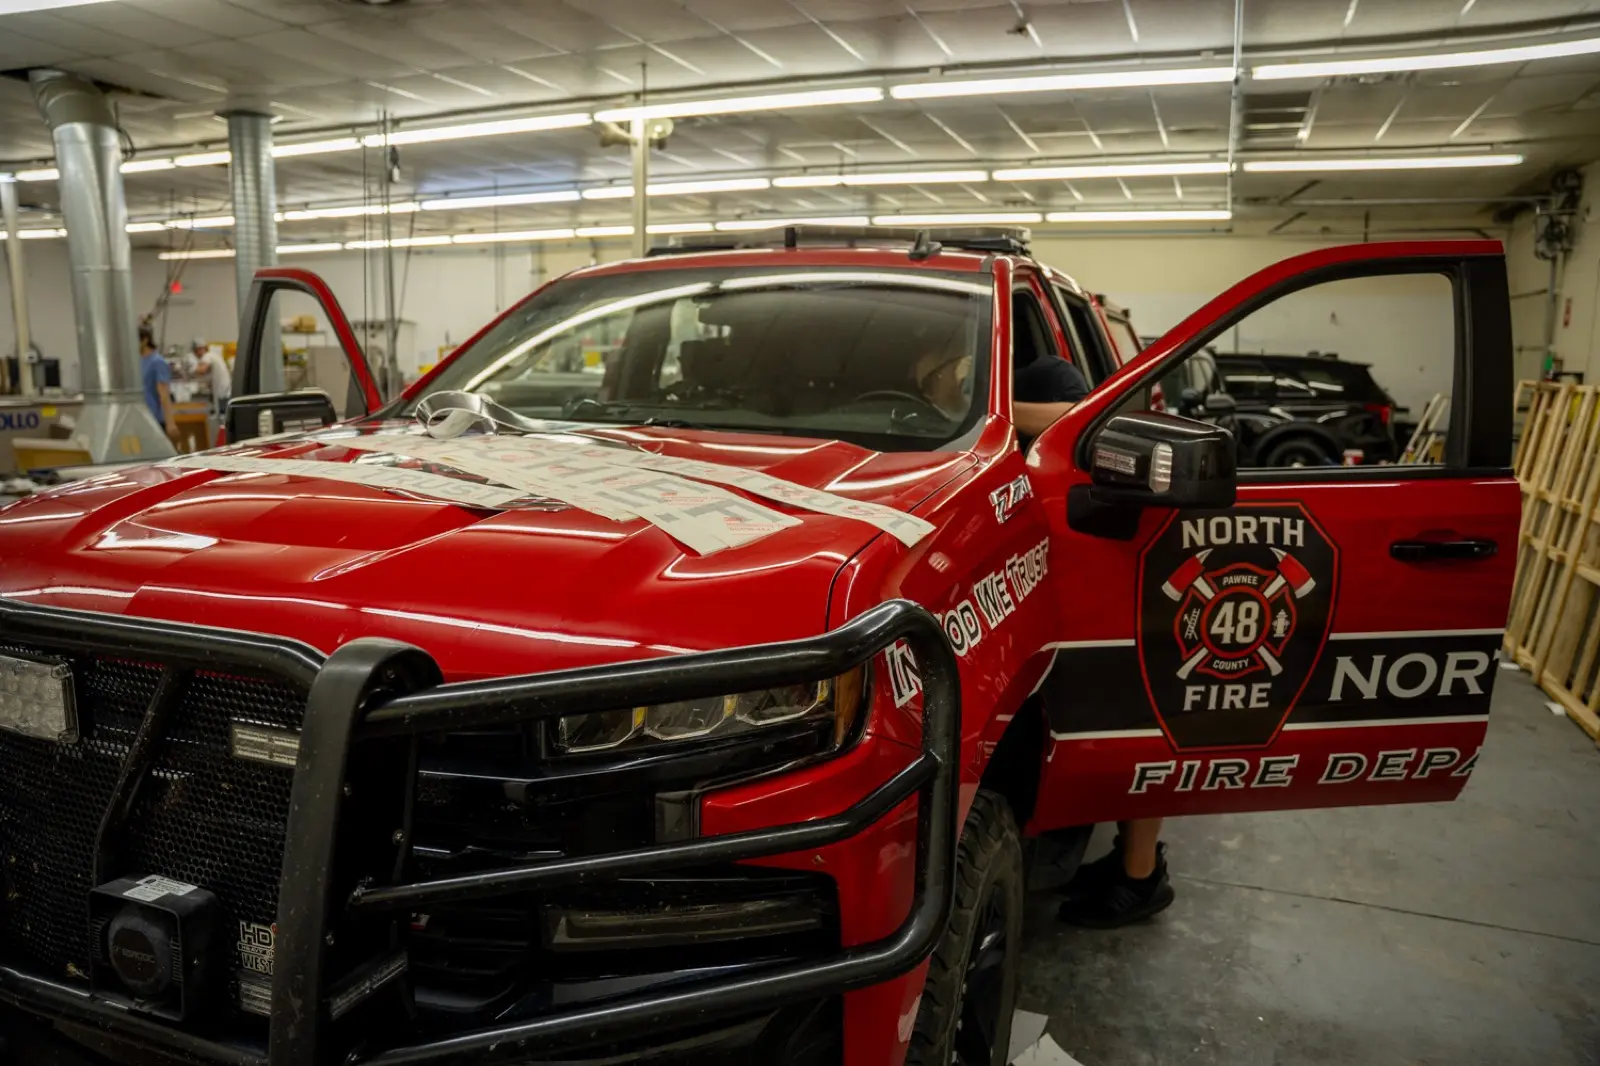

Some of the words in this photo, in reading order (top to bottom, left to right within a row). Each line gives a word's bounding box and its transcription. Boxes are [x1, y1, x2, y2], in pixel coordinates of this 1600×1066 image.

[1181, 515, 1305, 549] NORTH
[933, 599, 982, 657] OD
[974, 571, 1016, 630] WE
[1006, 536, 1049, 603] TRUST
[1222, 575, 1258, 586] PAWNEE
[1210, 601, 1260, 644] 48
[1213, 658, 1249, 670] COUNTY
[1328, 649, 1501, 701] NOR
[1183, 682, 1272, 711] FIRE
[1128, 754, 1299, 794] FIRE
[240, 921, 274, 949] HD
